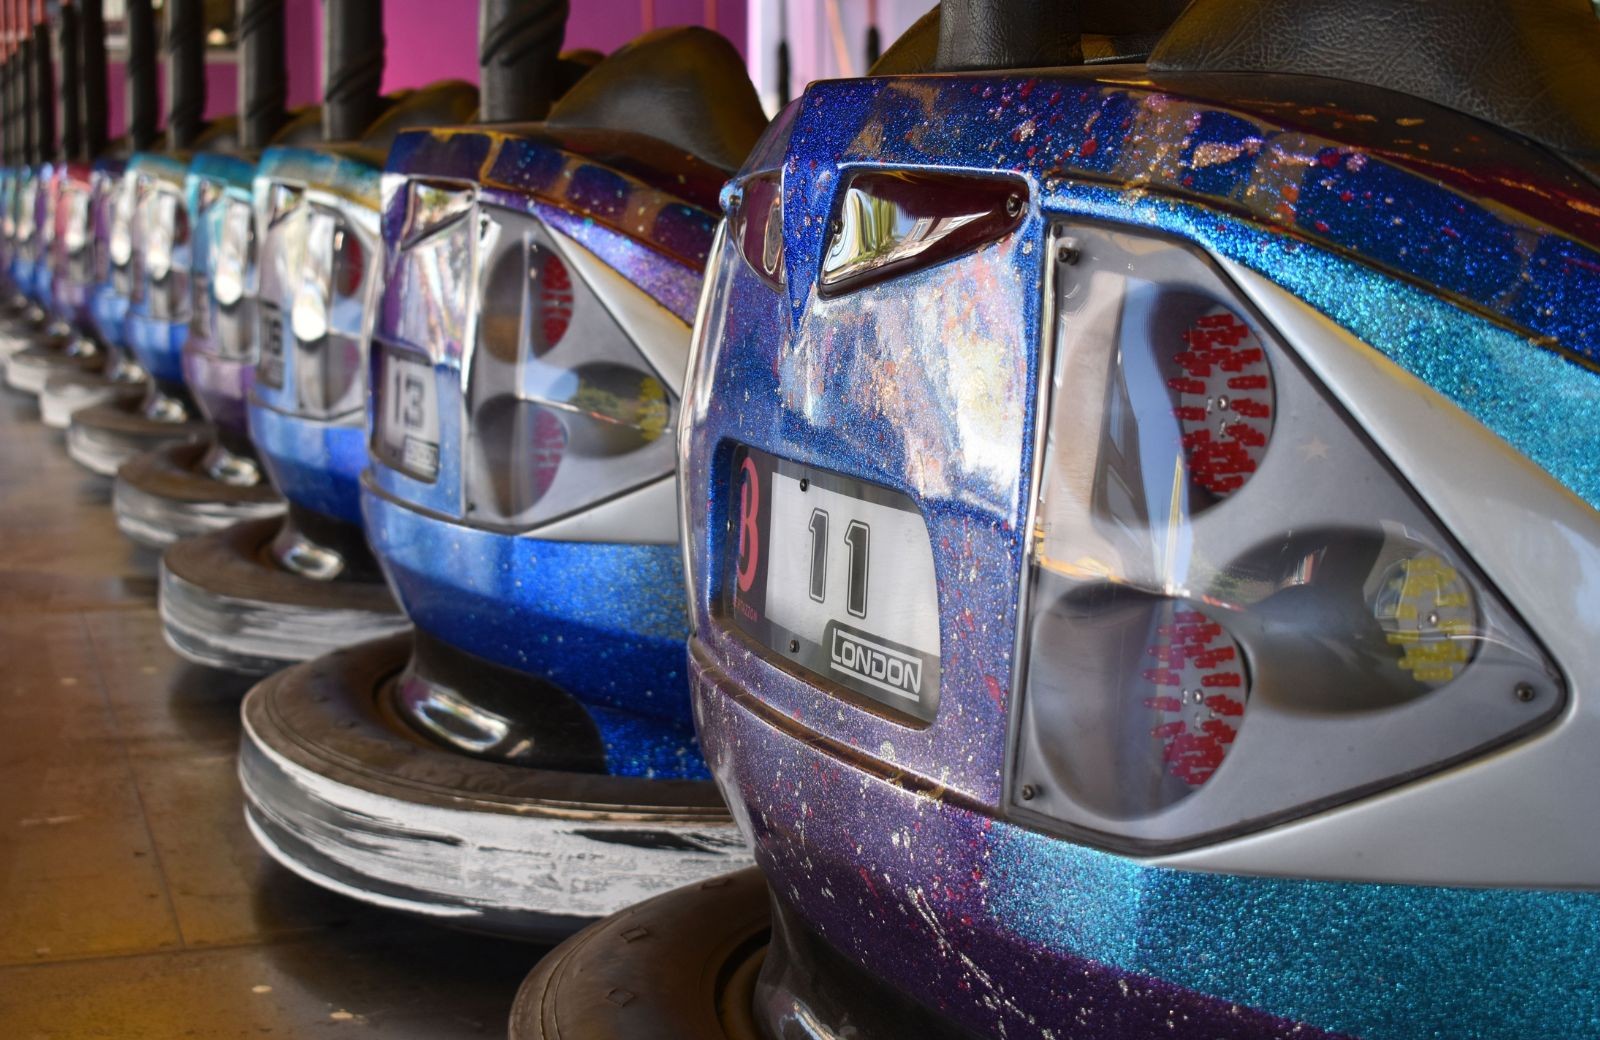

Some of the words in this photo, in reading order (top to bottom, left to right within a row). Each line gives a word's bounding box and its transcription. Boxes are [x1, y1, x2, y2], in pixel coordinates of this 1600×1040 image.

[394, 368, 425, 429] 13
[808, 506, 871, 619] 11
[830, 627, 922, 698] LONDON
